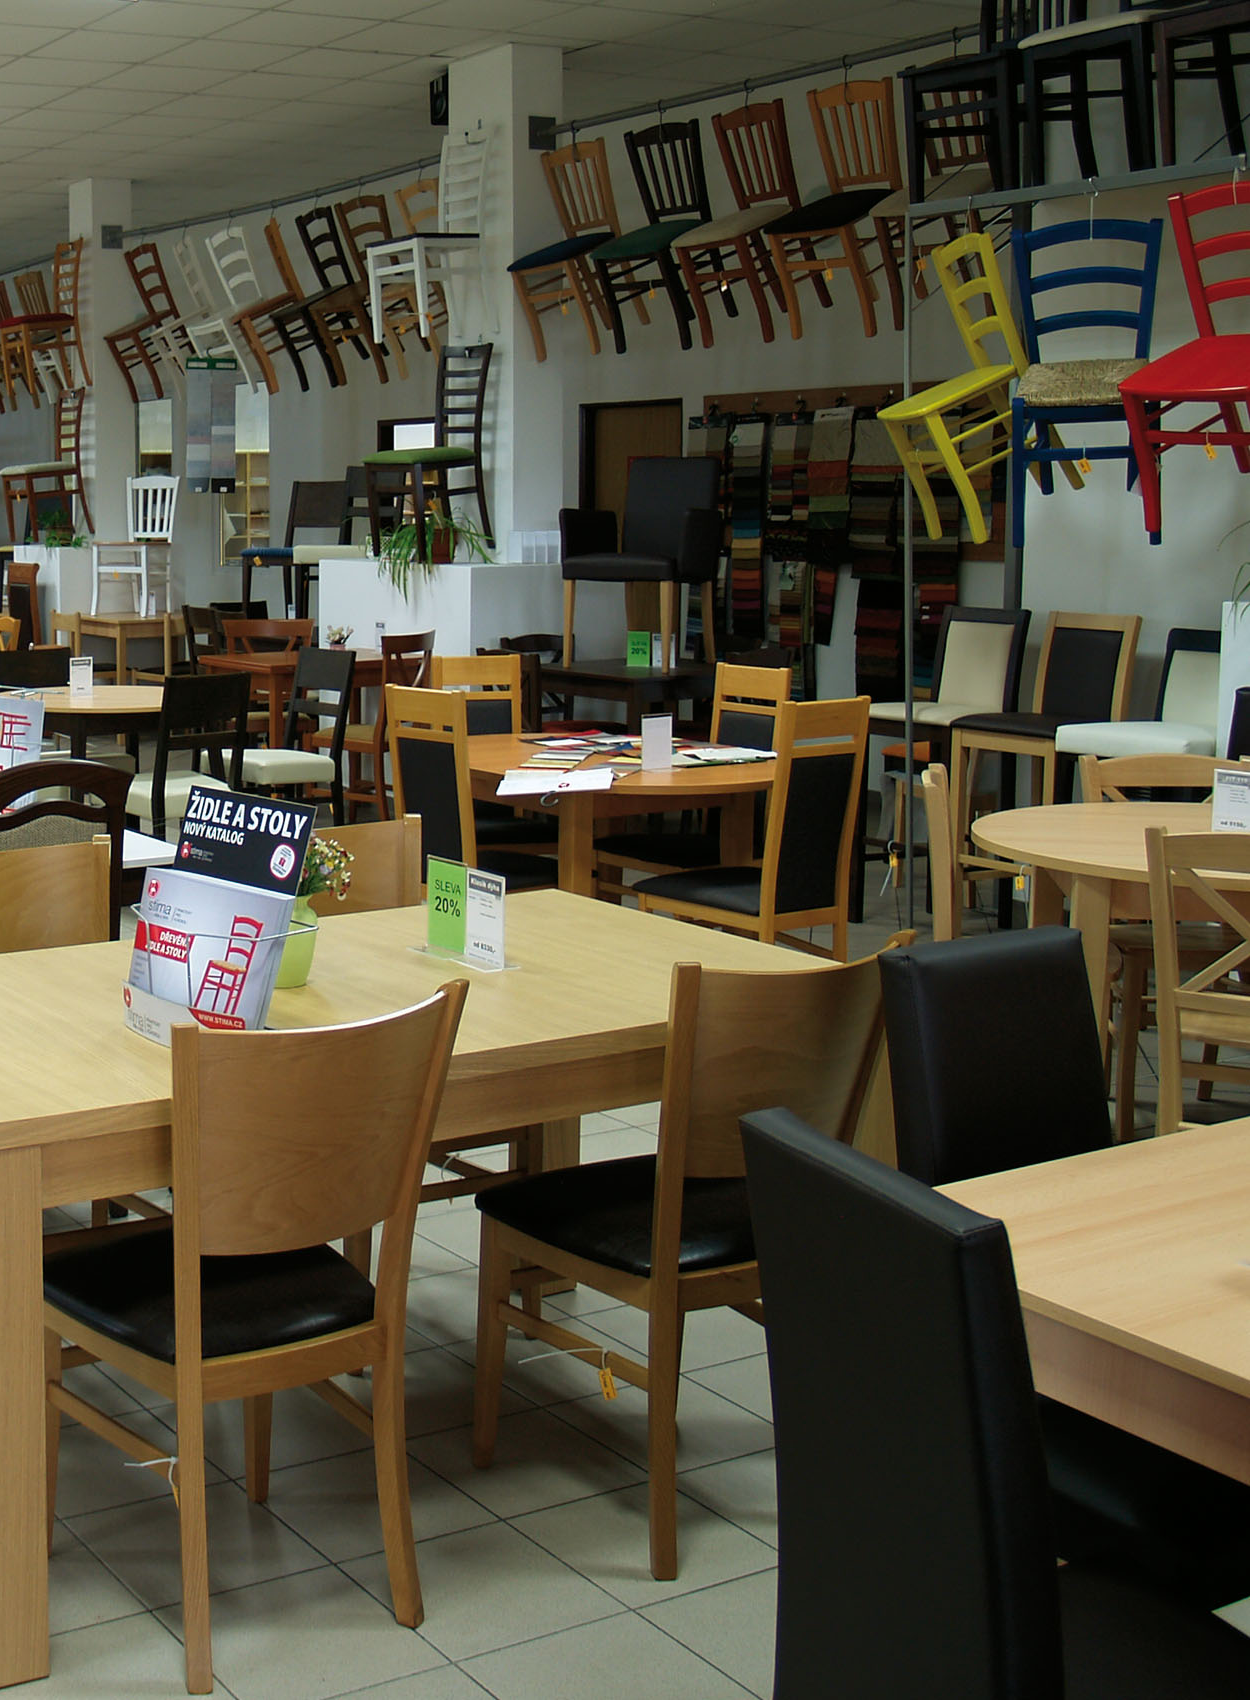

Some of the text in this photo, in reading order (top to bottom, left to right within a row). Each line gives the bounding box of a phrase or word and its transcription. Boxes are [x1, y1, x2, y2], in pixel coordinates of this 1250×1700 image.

[187, 790, 308, 840] ŽIDLE A STOLY
[183, 820, 245, 846] NOVÝ KATALOG
[434, 879, 461, 896] SLEVA
[434, 895, 461, 918] 20%
[165, 945, 188, 960] STOLY
